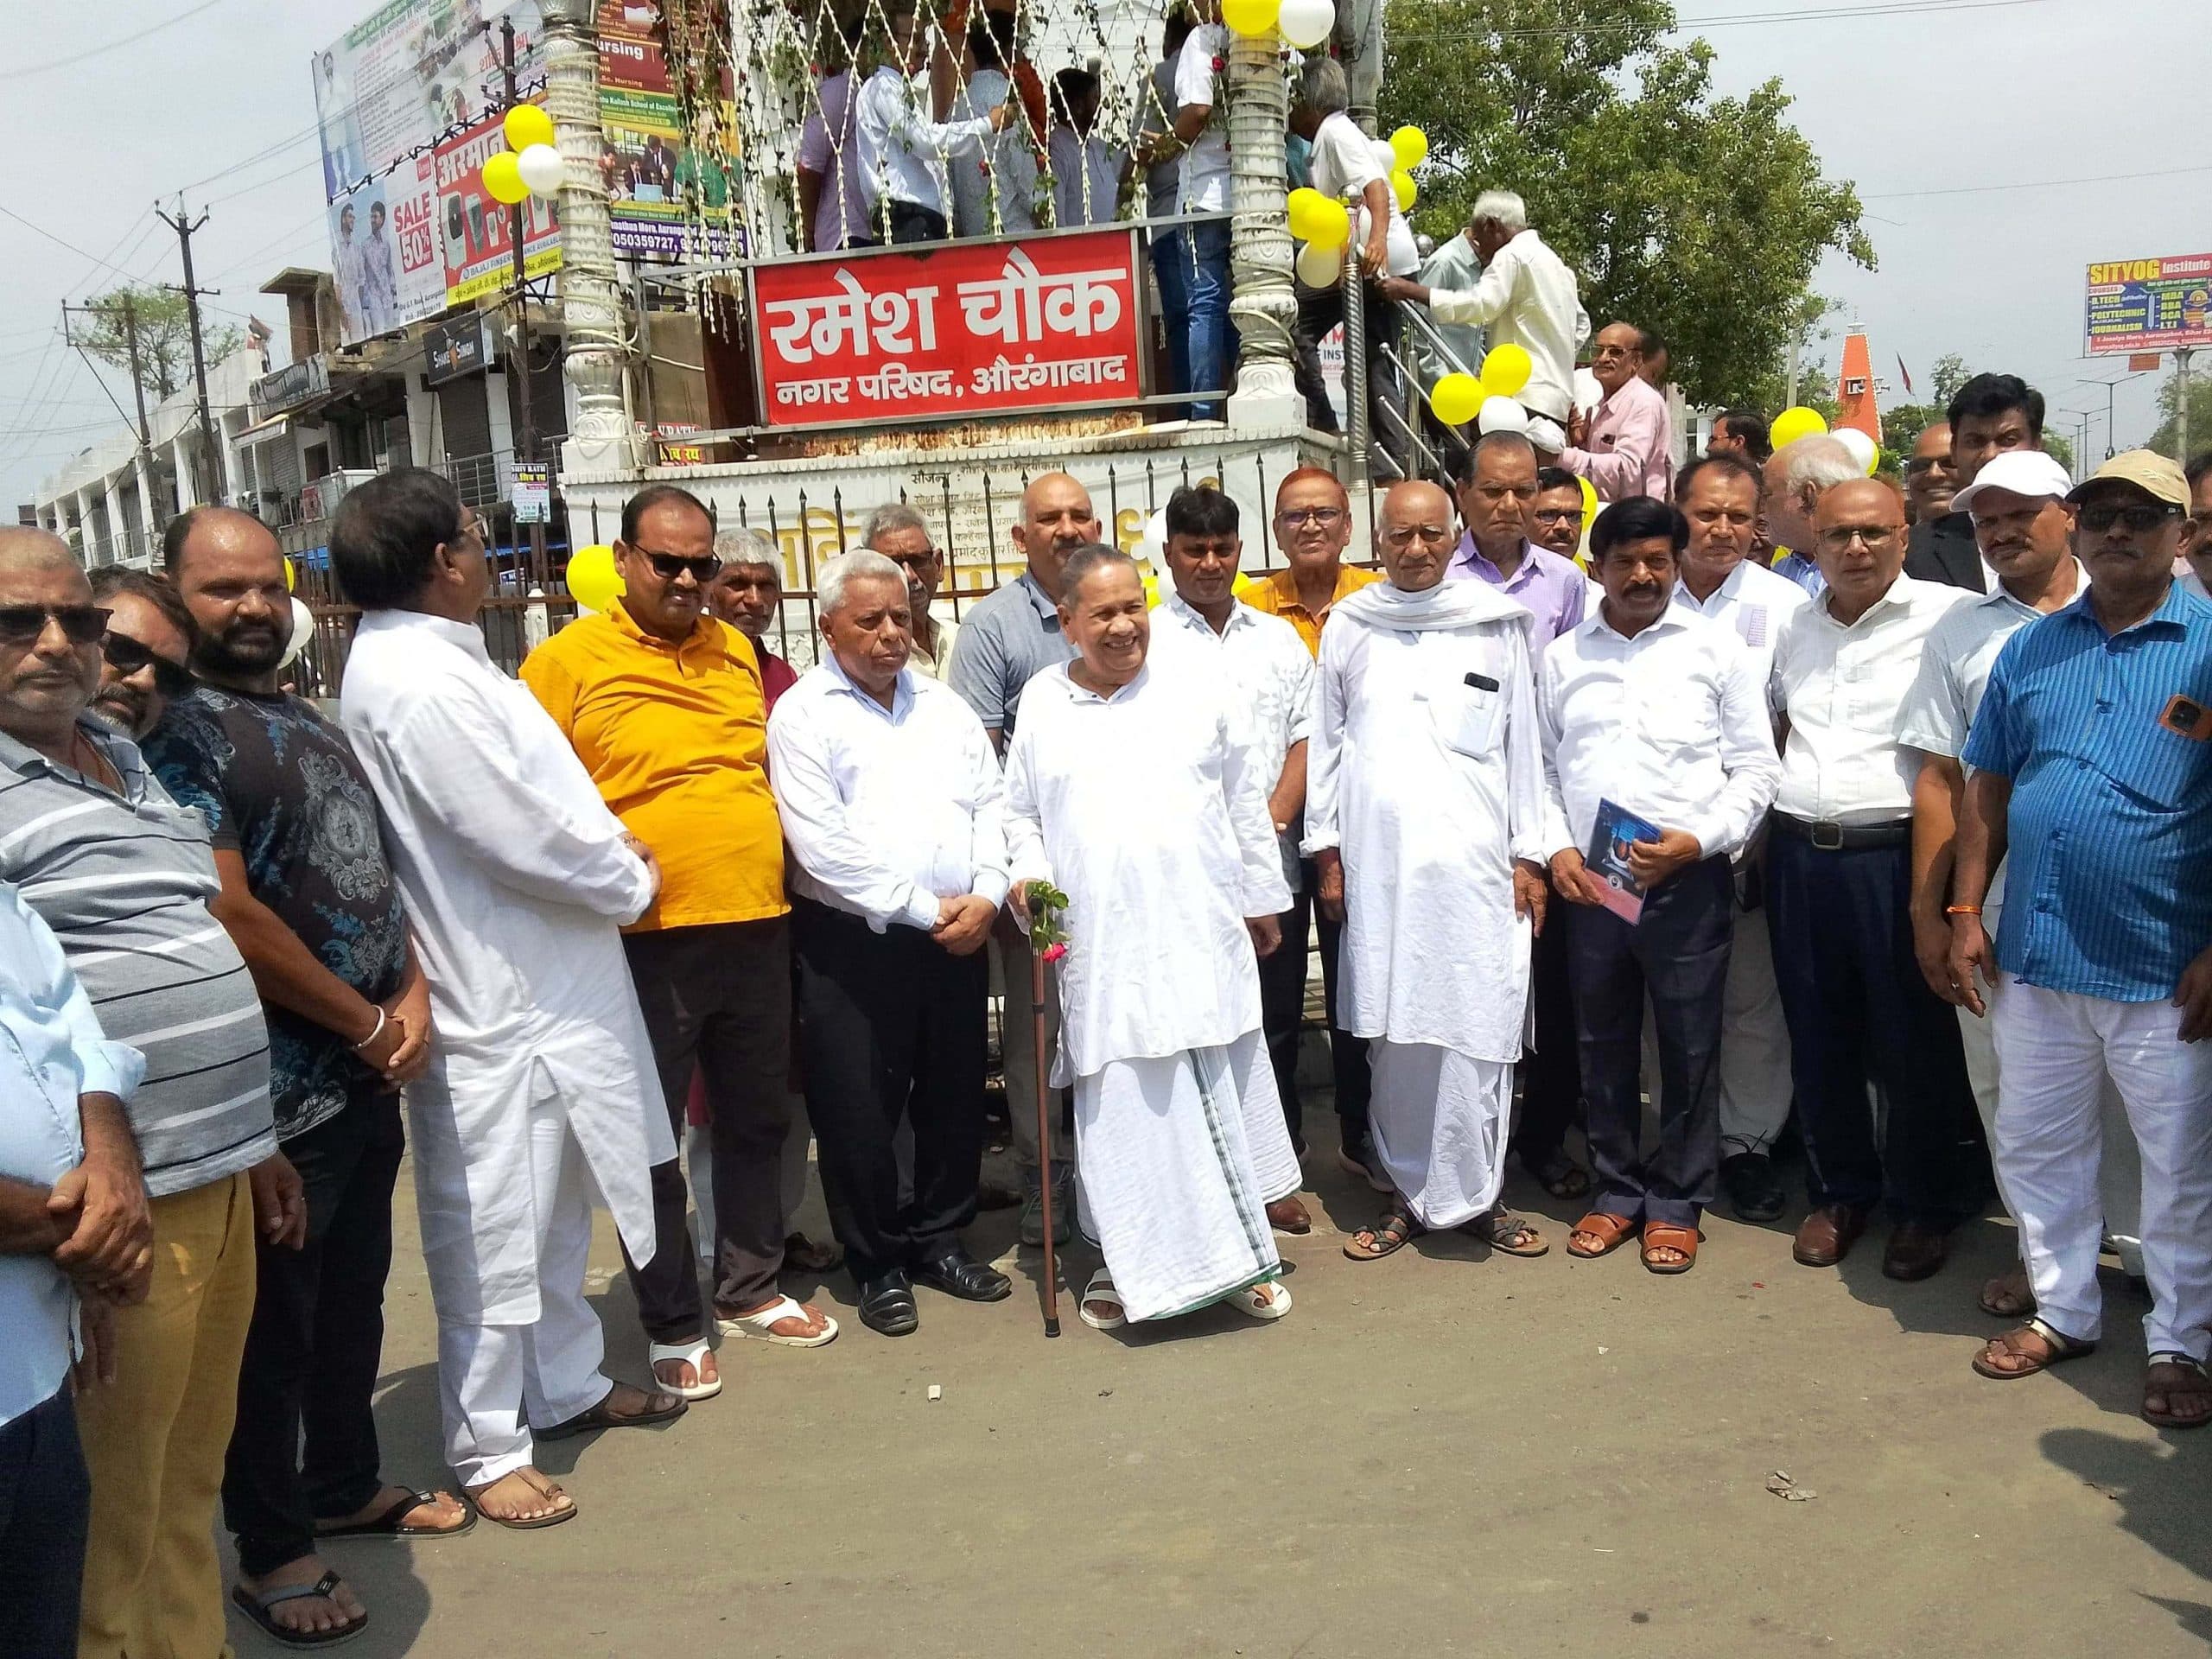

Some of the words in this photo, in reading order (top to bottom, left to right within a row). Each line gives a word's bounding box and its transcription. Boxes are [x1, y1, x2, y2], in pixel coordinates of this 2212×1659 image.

[596, 41, 644, 60] ursing
[393, 190, 432, 233] SALE
[401, 226, 430, 269] 50%
[613, 232, 678, 251] 050359727,
[2089, 259, 2160, 285] SITYOG
[2162, 259, 2211, 274] Institute
[766, 267, 939, 363] रमेश
[957, 244, 1127, 344] चौक
[1323, 349, 1344, 360] INS
[775, 377, 851, 407] नगर
[857, 363, 964, 401] परिषद,
[969, 353, 1128, 393] औरंगाबाद
[912, 469, 951, 484] सौजन्य
